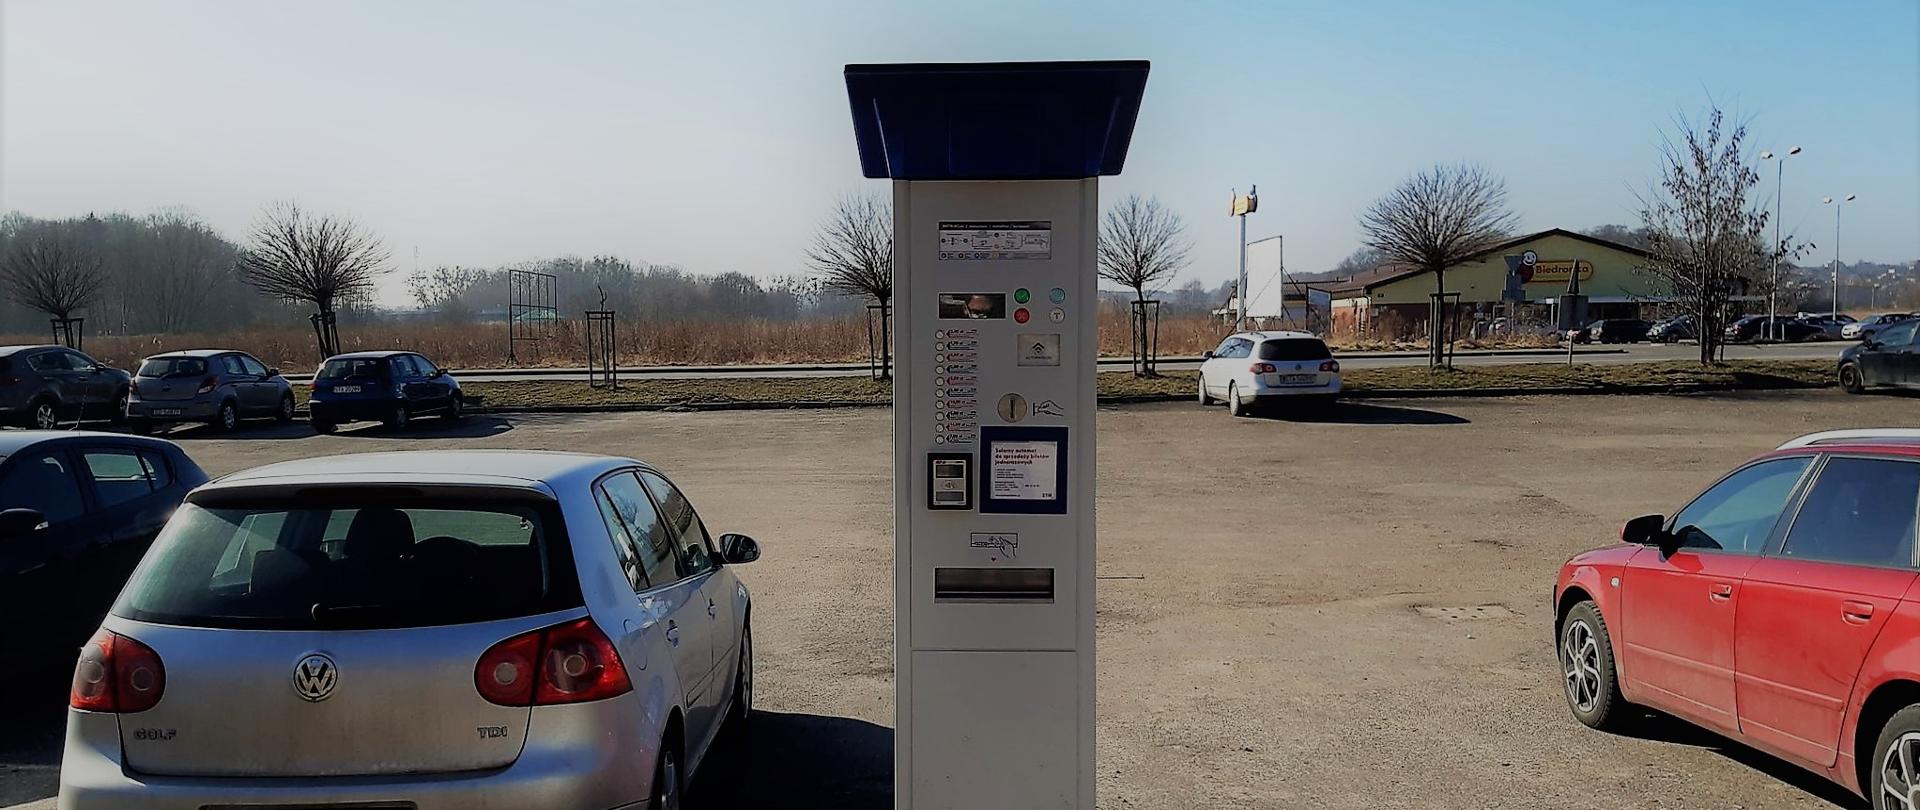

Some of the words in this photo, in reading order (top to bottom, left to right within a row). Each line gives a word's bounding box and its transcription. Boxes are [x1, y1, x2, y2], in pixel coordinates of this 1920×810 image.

[296, 657, 335, 695] VW
[134, 728, 176, 740] GOLF
[476, 726, 507, 738] TDI
